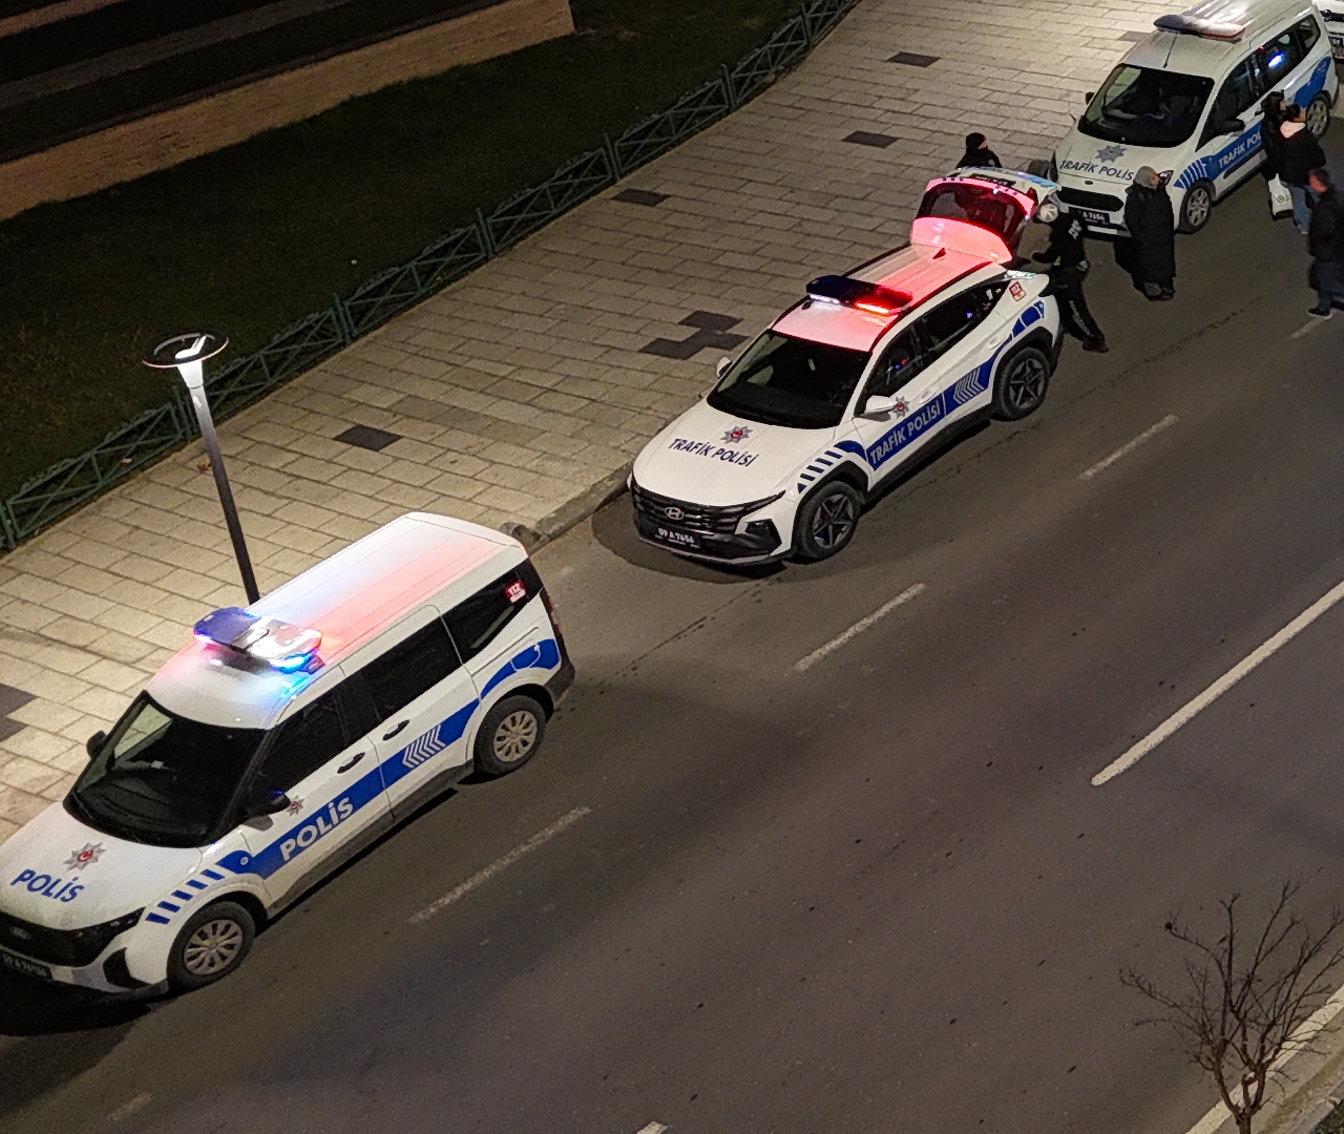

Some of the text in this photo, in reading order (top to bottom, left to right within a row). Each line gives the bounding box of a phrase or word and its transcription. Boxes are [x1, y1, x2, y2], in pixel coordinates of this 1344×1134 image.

[1060, 160, 1098, 173] TRAFİK
[870, 399, 941, 464] TRAFİK POLİSİ
[668, 438, 759, 467] TRAFİK POLİSİ
[280, 797, 353, 861] POLİS
[10, 868, 85, 902] POLİS
